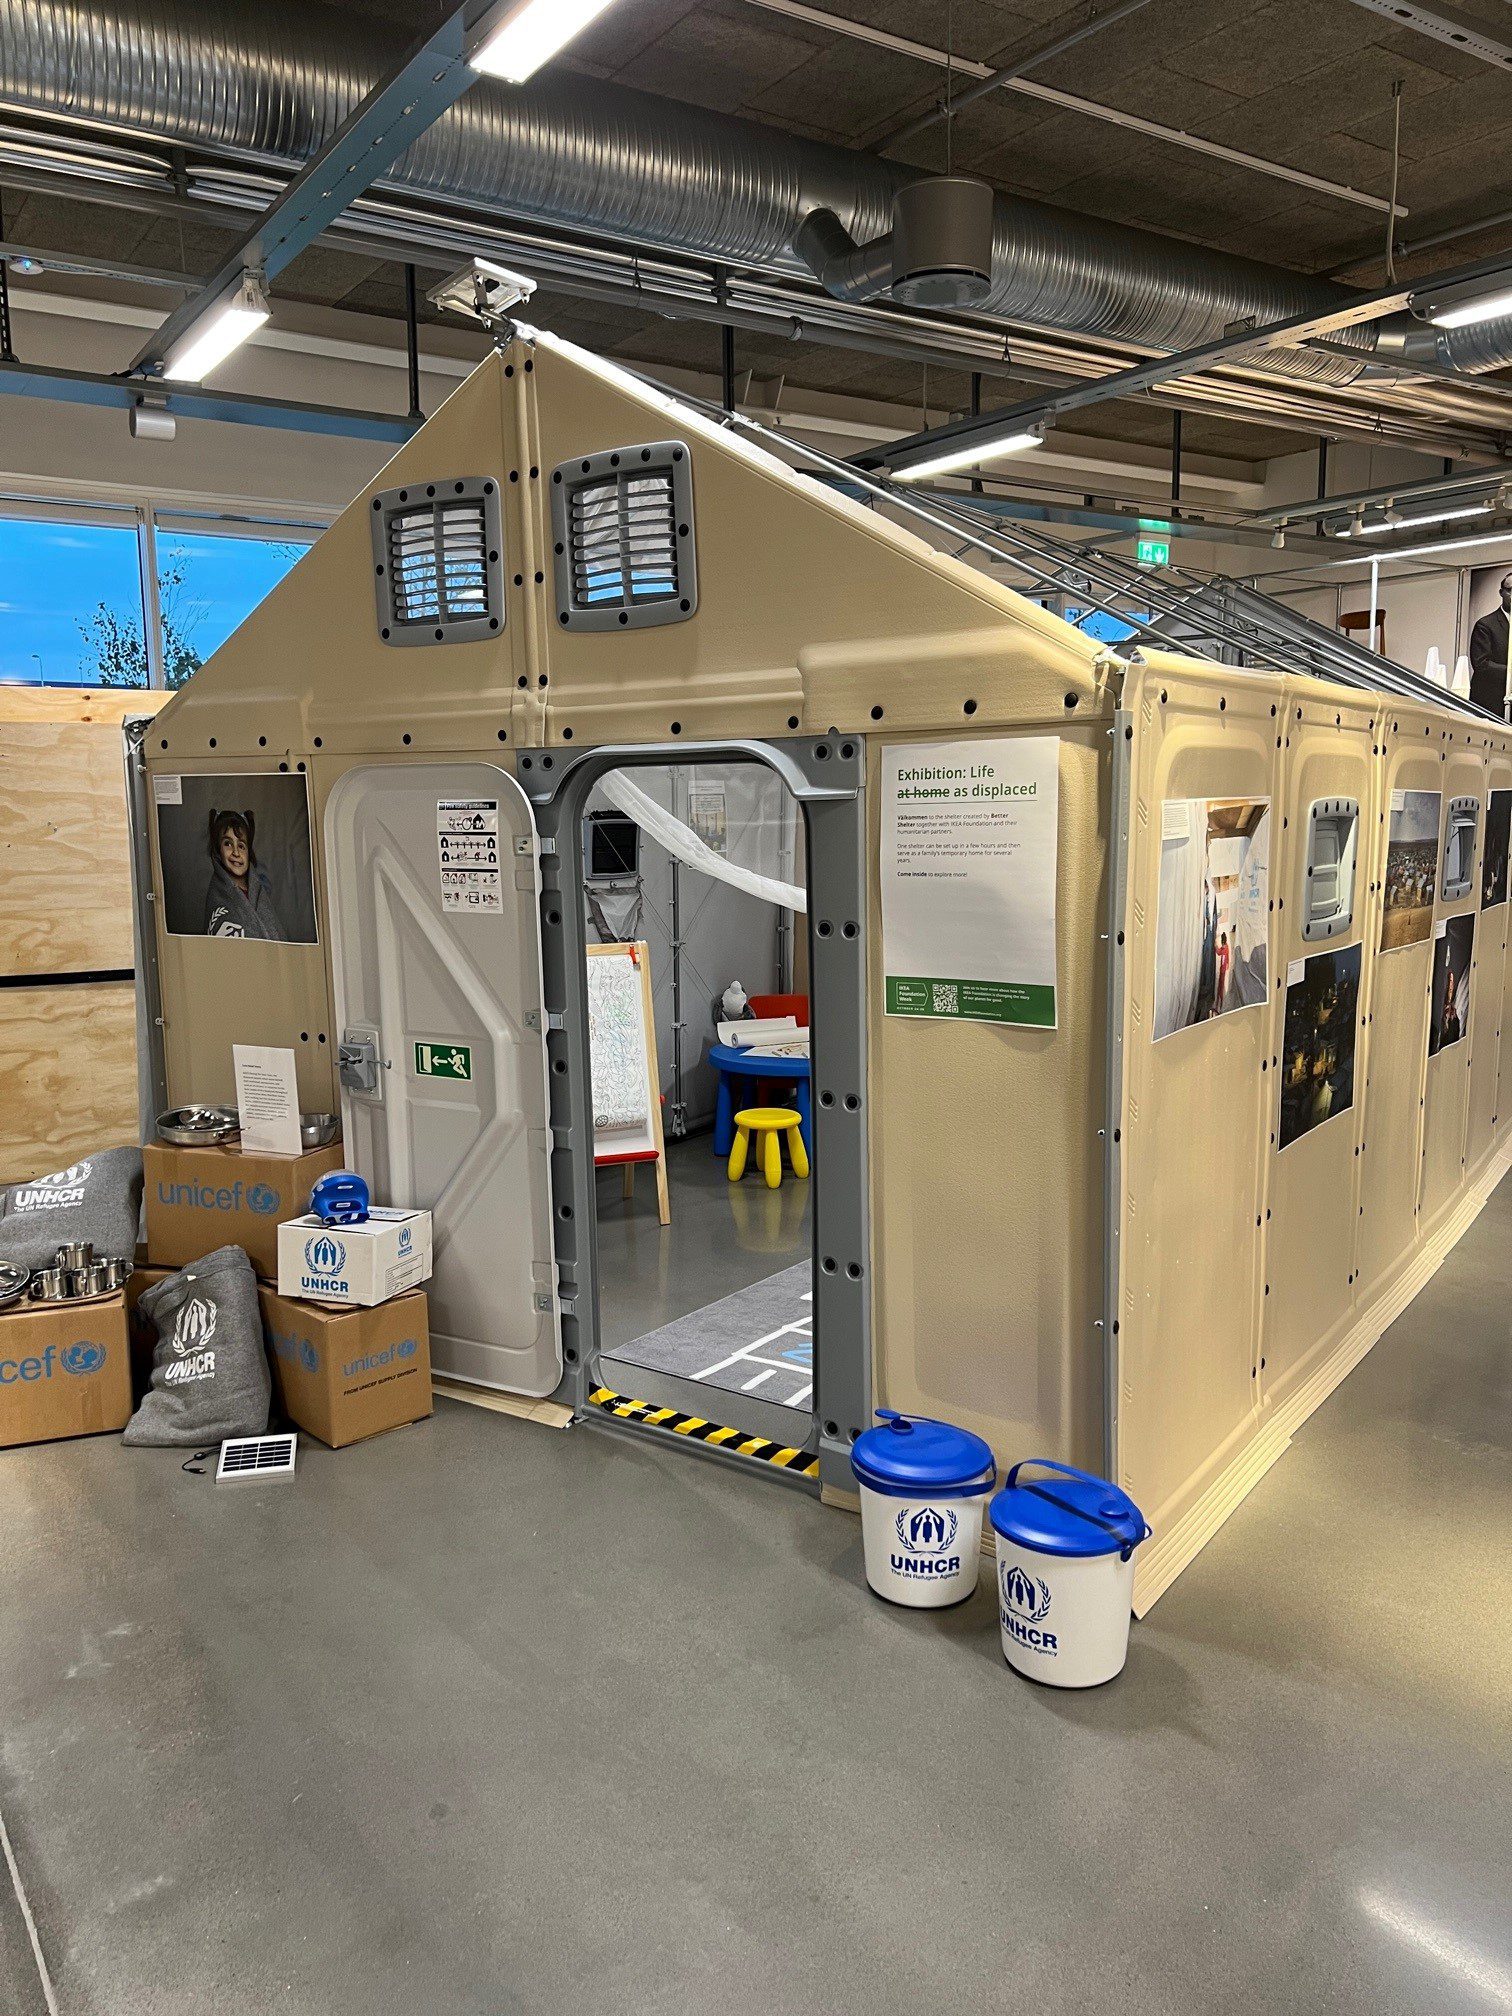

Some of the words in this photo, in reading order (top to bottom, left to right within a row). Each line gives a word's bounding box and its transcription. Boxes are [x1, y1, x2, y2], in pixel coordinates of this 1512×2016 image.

[898, 767, 966, 781] Exhibition:
[970, 766, 995, 778] Life
[898, 788, 910, 799] at
[914, 786, 950, 798] home
[954, 788, 968, 797] as
[972, 782, 1037, 799] displaced
[15, 1188, 85, 1207] UNHCR
[158, 1178, 243, 1211] unicef
[36, 1203, 59, 1211] Refugee
[59, 1200, 83, 1209] Agency
[302, 1277, 349, 1293] UNHCR
[0, 1345, 57, 1384] cef
[165, 1352, 215, 1380] UNHCR
[343, 1344, 395, 1377] unicef
[344, 1387, 359, 1396] FROM
[359, 1380, 378, 1392] UNICEF
[378, 1374, 397, 1385] SUPPLY
[397, 1368, 418, 1380] DIVISION
[890, 1554, 960, 1574] UNHCR
[913, 1573, 938, 1581] Refugee
[939, 1572, 960, 1581] Agency
[1000, 1609, 1058, 1649] UNHCR
[1034, 1645, 1058, 1657] Agency
